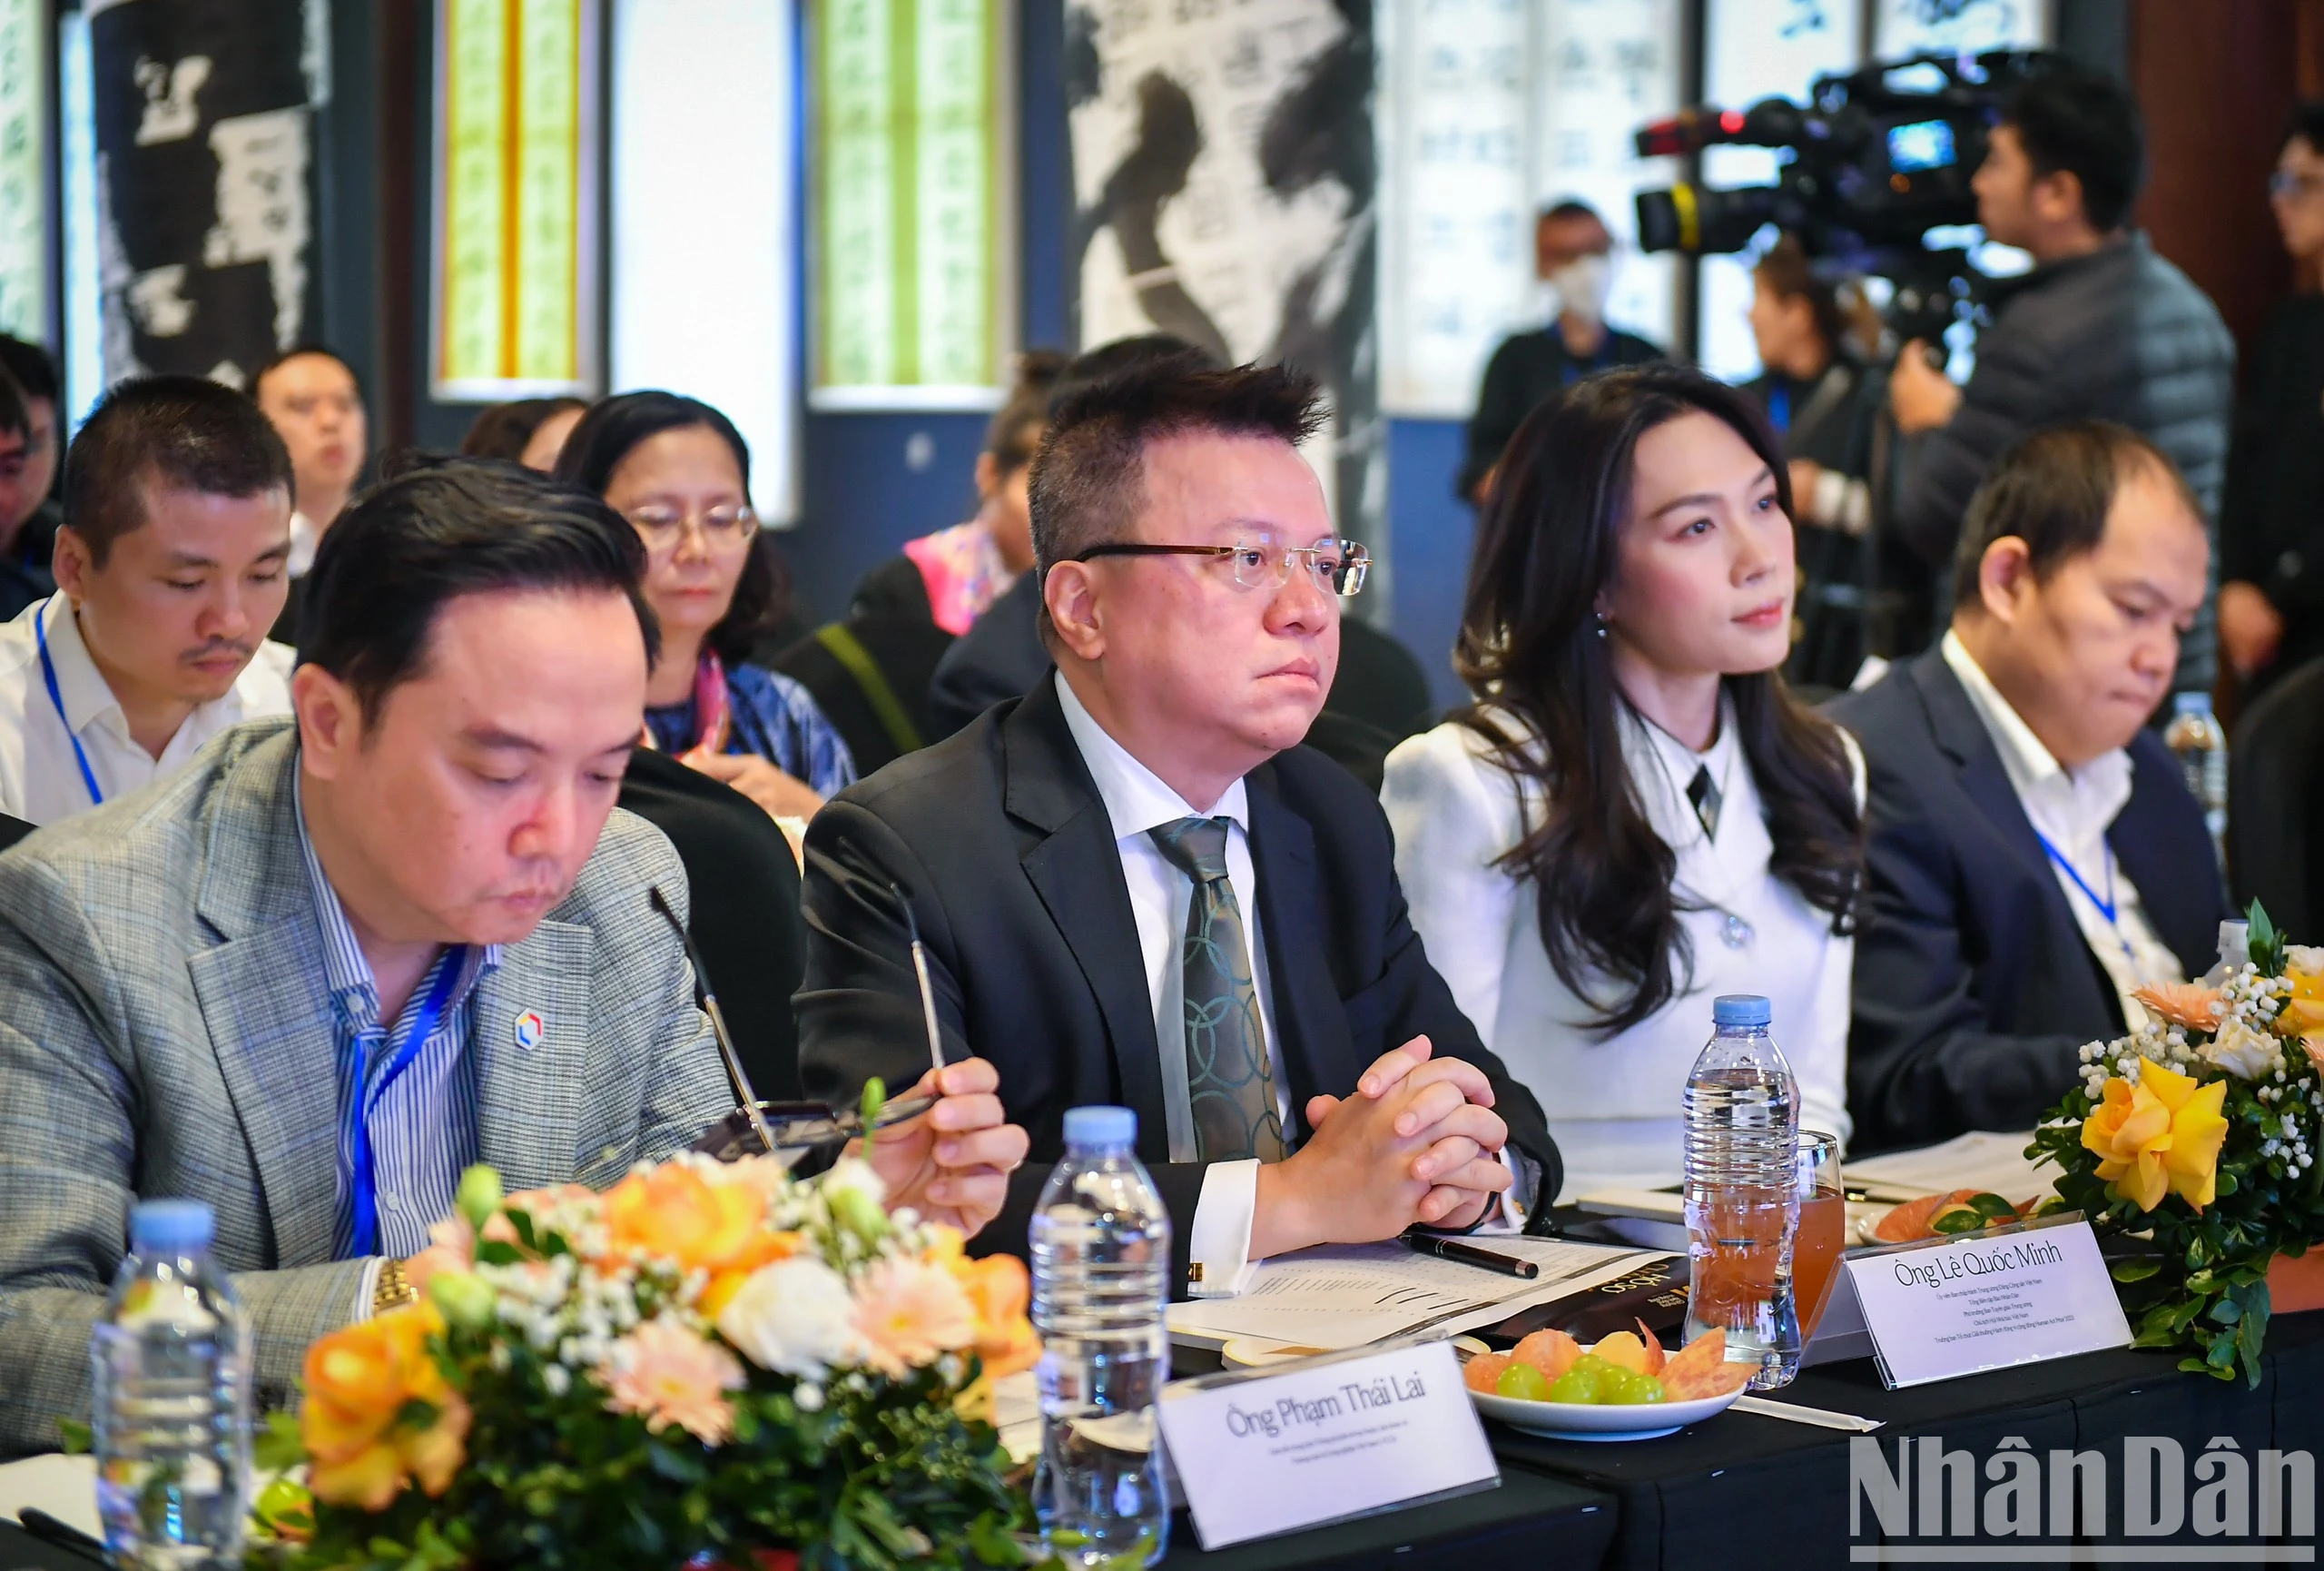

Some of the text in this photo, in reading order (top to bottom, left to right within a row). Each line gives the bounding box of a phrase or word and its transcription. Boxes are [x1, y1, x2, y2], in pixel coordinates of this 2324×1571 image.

[1895, 1240, 2063, 1288] Ông Lê Quốc Minh
[1275, 1396, 1343, 1427] Phạm
[1391, 1370, 1426, 1401] Lai
